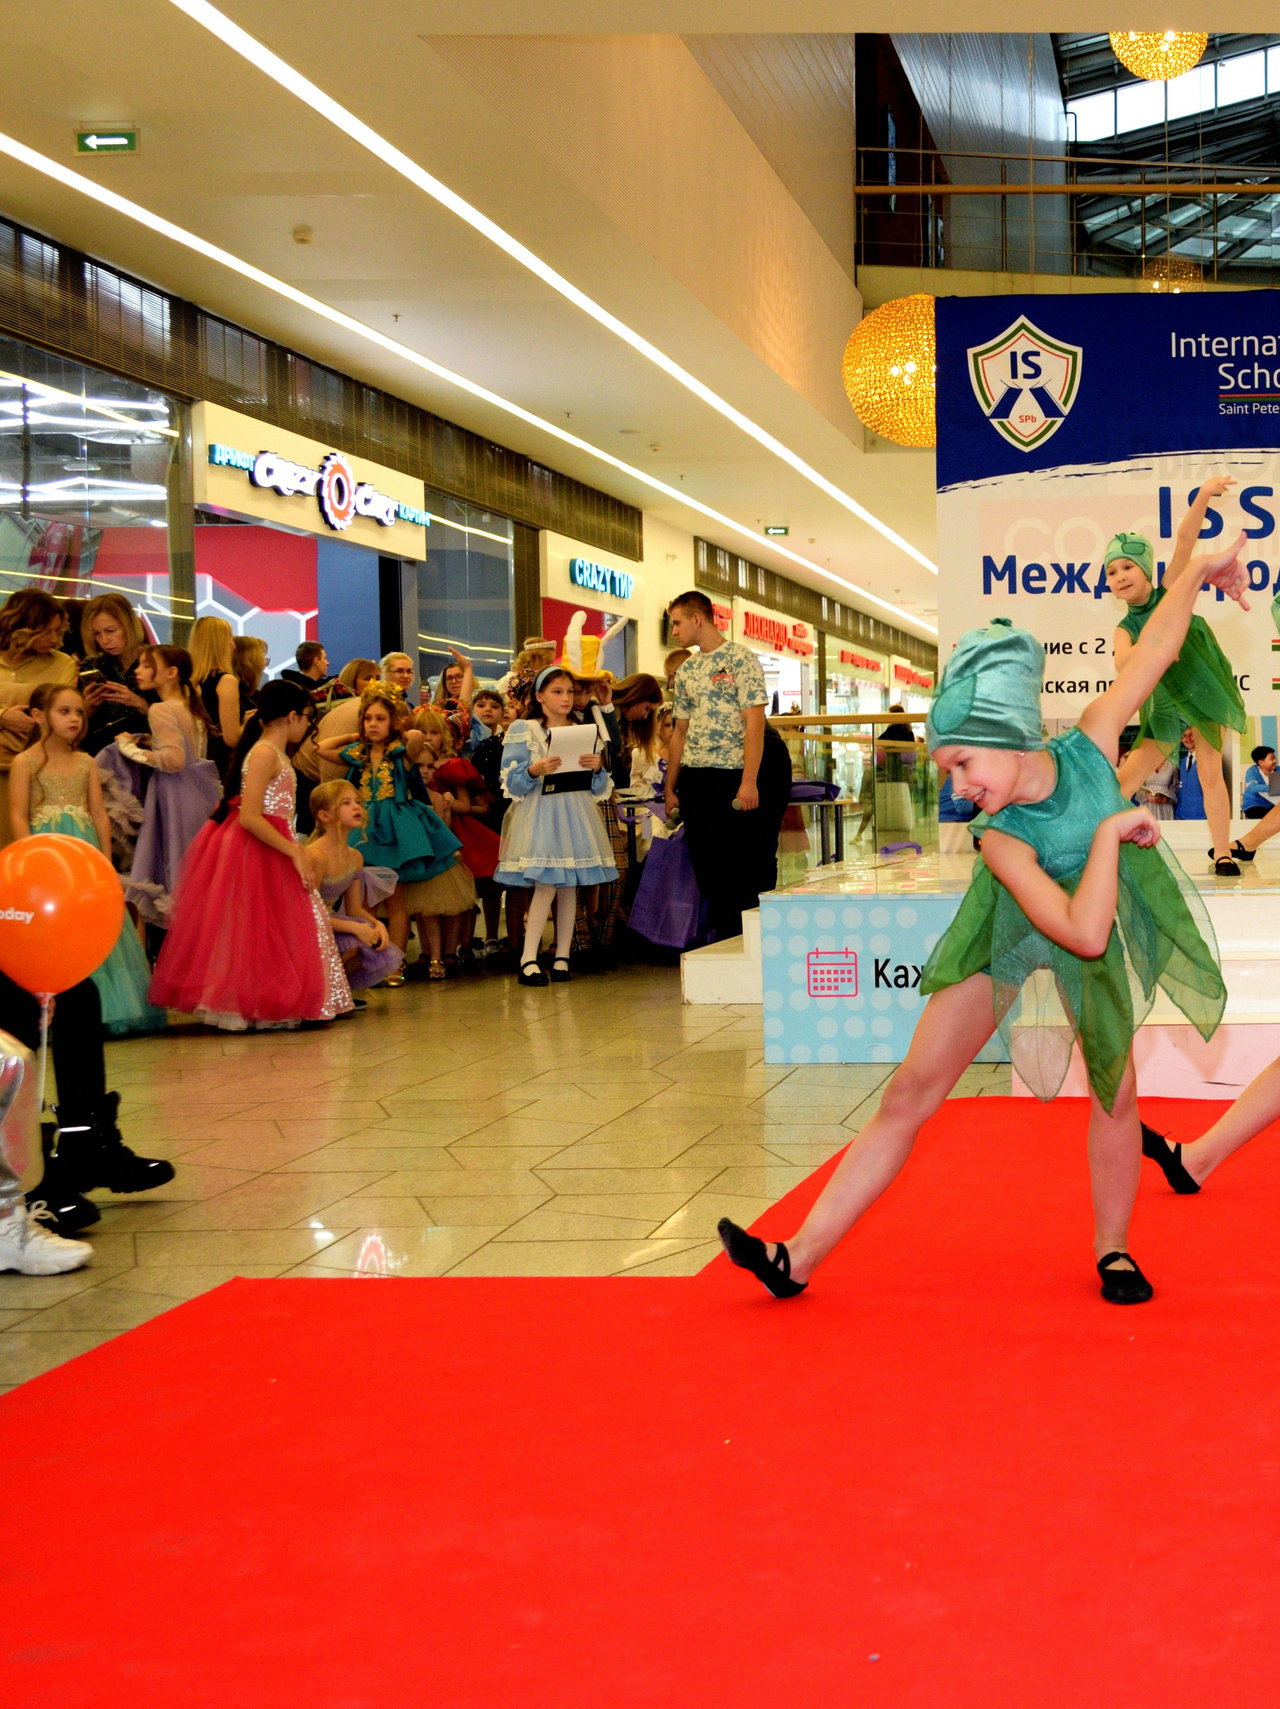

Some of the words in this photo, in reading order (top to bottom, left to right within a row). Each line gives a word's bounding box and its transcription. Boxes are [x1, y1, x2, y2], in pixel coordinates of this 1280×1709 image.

[1009, 350, 1042, 380] IS
[1018, 414, 1038, 424] SPb
[1218, 403, 1250, 416] Saint
[209, 444, 256, 472] ДРИФТ
[570, 557, 612, 595] CRAZY
[612, 572, 634, 600] ТИР
